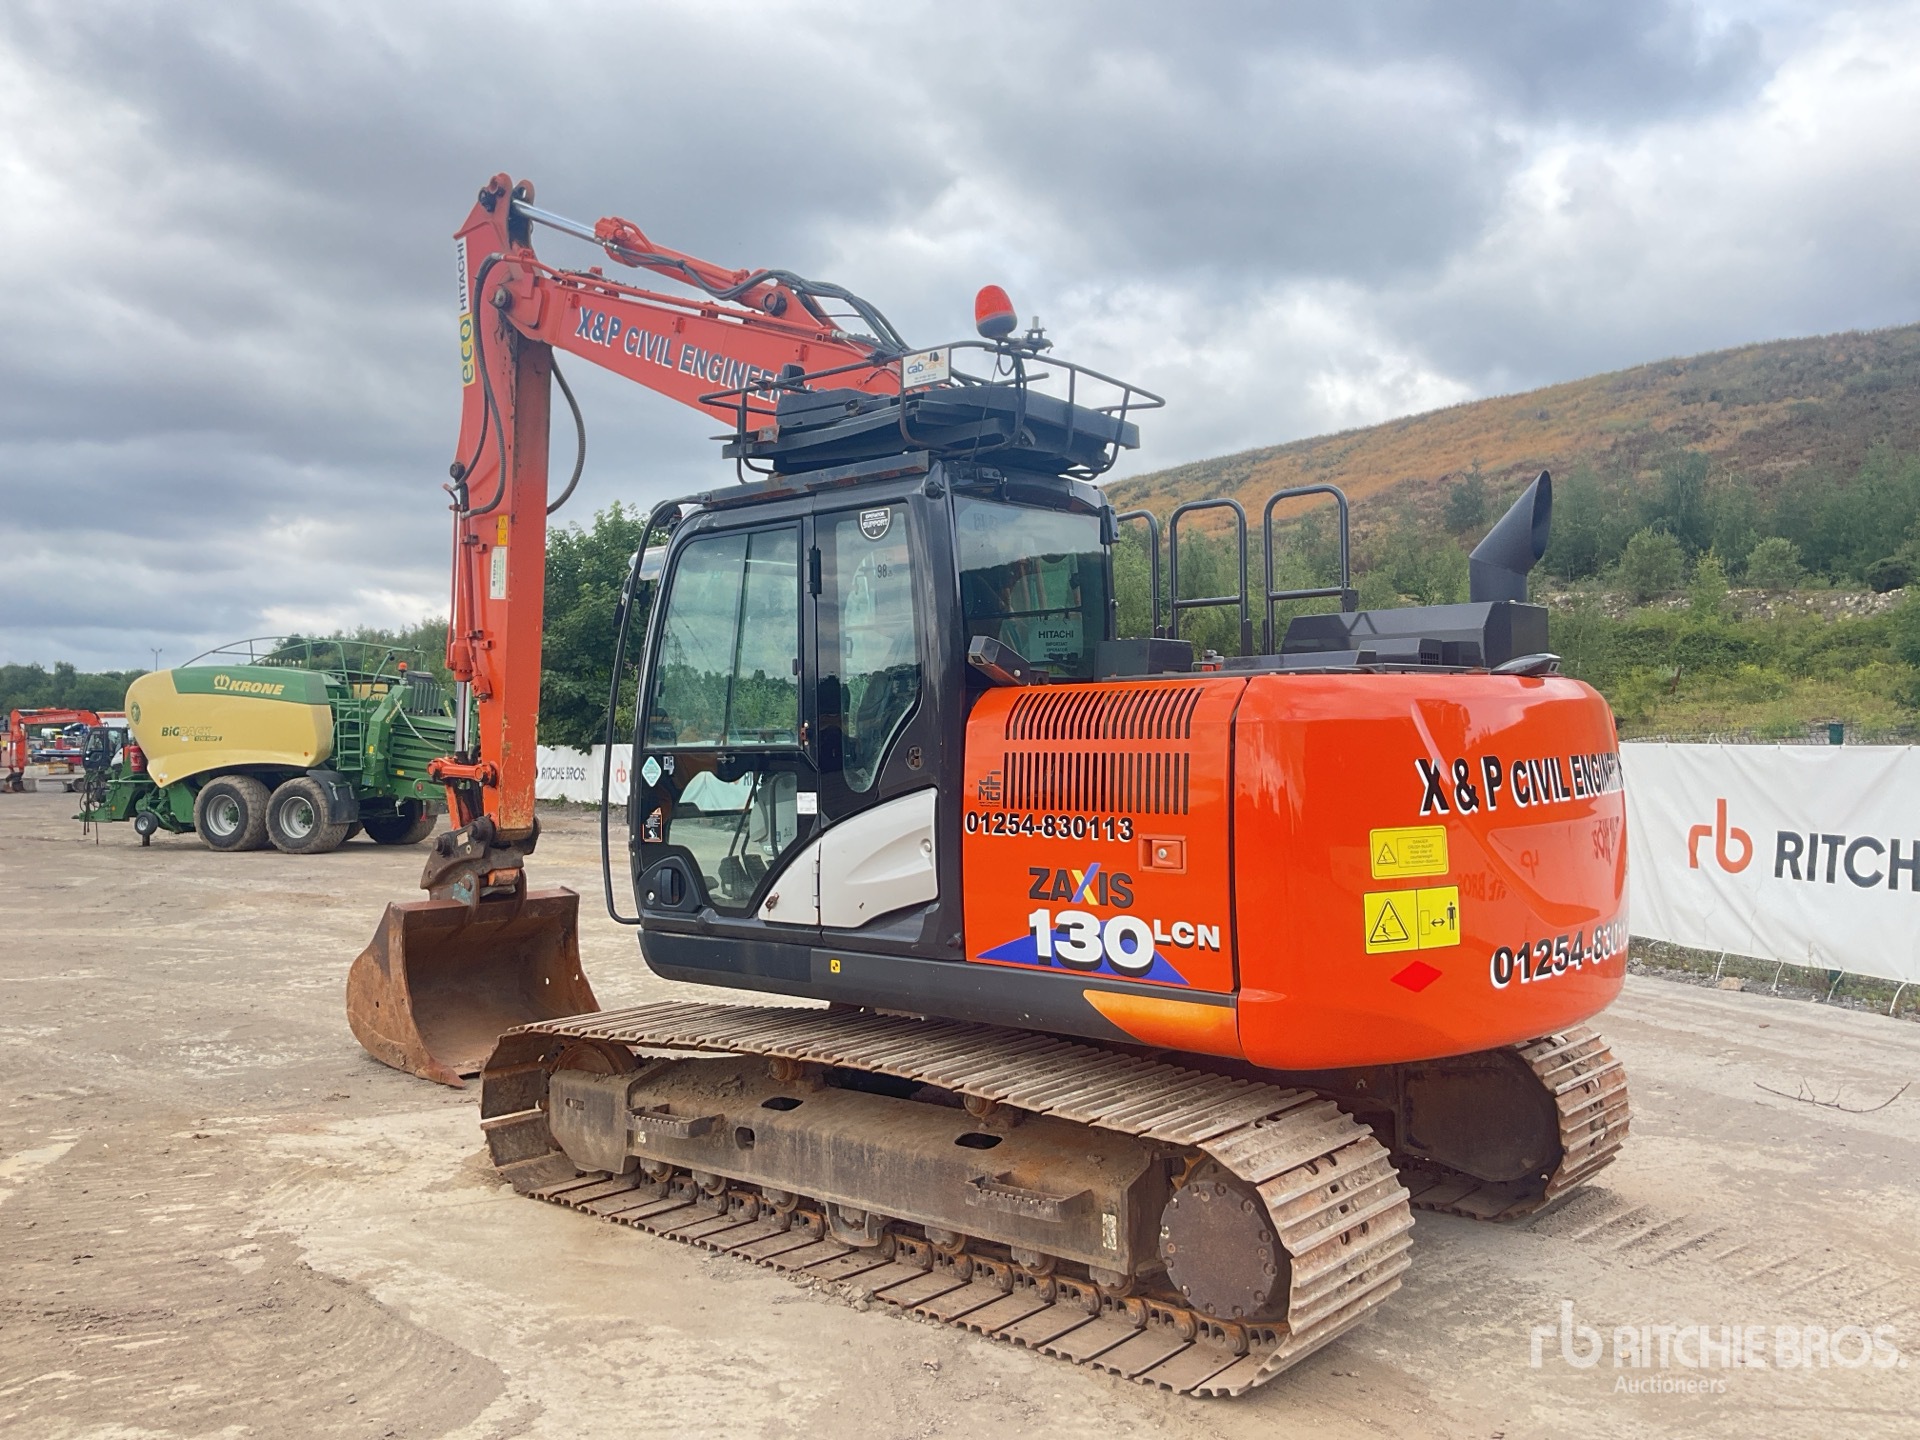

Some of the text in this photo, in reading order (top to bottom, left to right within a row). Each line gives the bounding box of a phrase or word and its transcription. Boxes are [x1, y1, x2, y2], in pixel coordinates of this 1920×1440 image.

[457, 242, 467, 311] HITACHI
[460, 319, 474, 384] eco
[624, 326, 674, 369] CIVIL
[1038, 630, 1074, 639] HITACHI
[229, 680, 285, 695] KRONE
[1415, 758, 1450, 816] X
[1452, 758, 1480, 815] &
[1480, 755, 1503, 811] P
[1510, 758, 1571, 808] CIVIL
[965, 811, 1134, 842] 01254-830113
[1688, 797, 1753, 874] rb
[1029, 862, 1134, 908] ZAXIS
